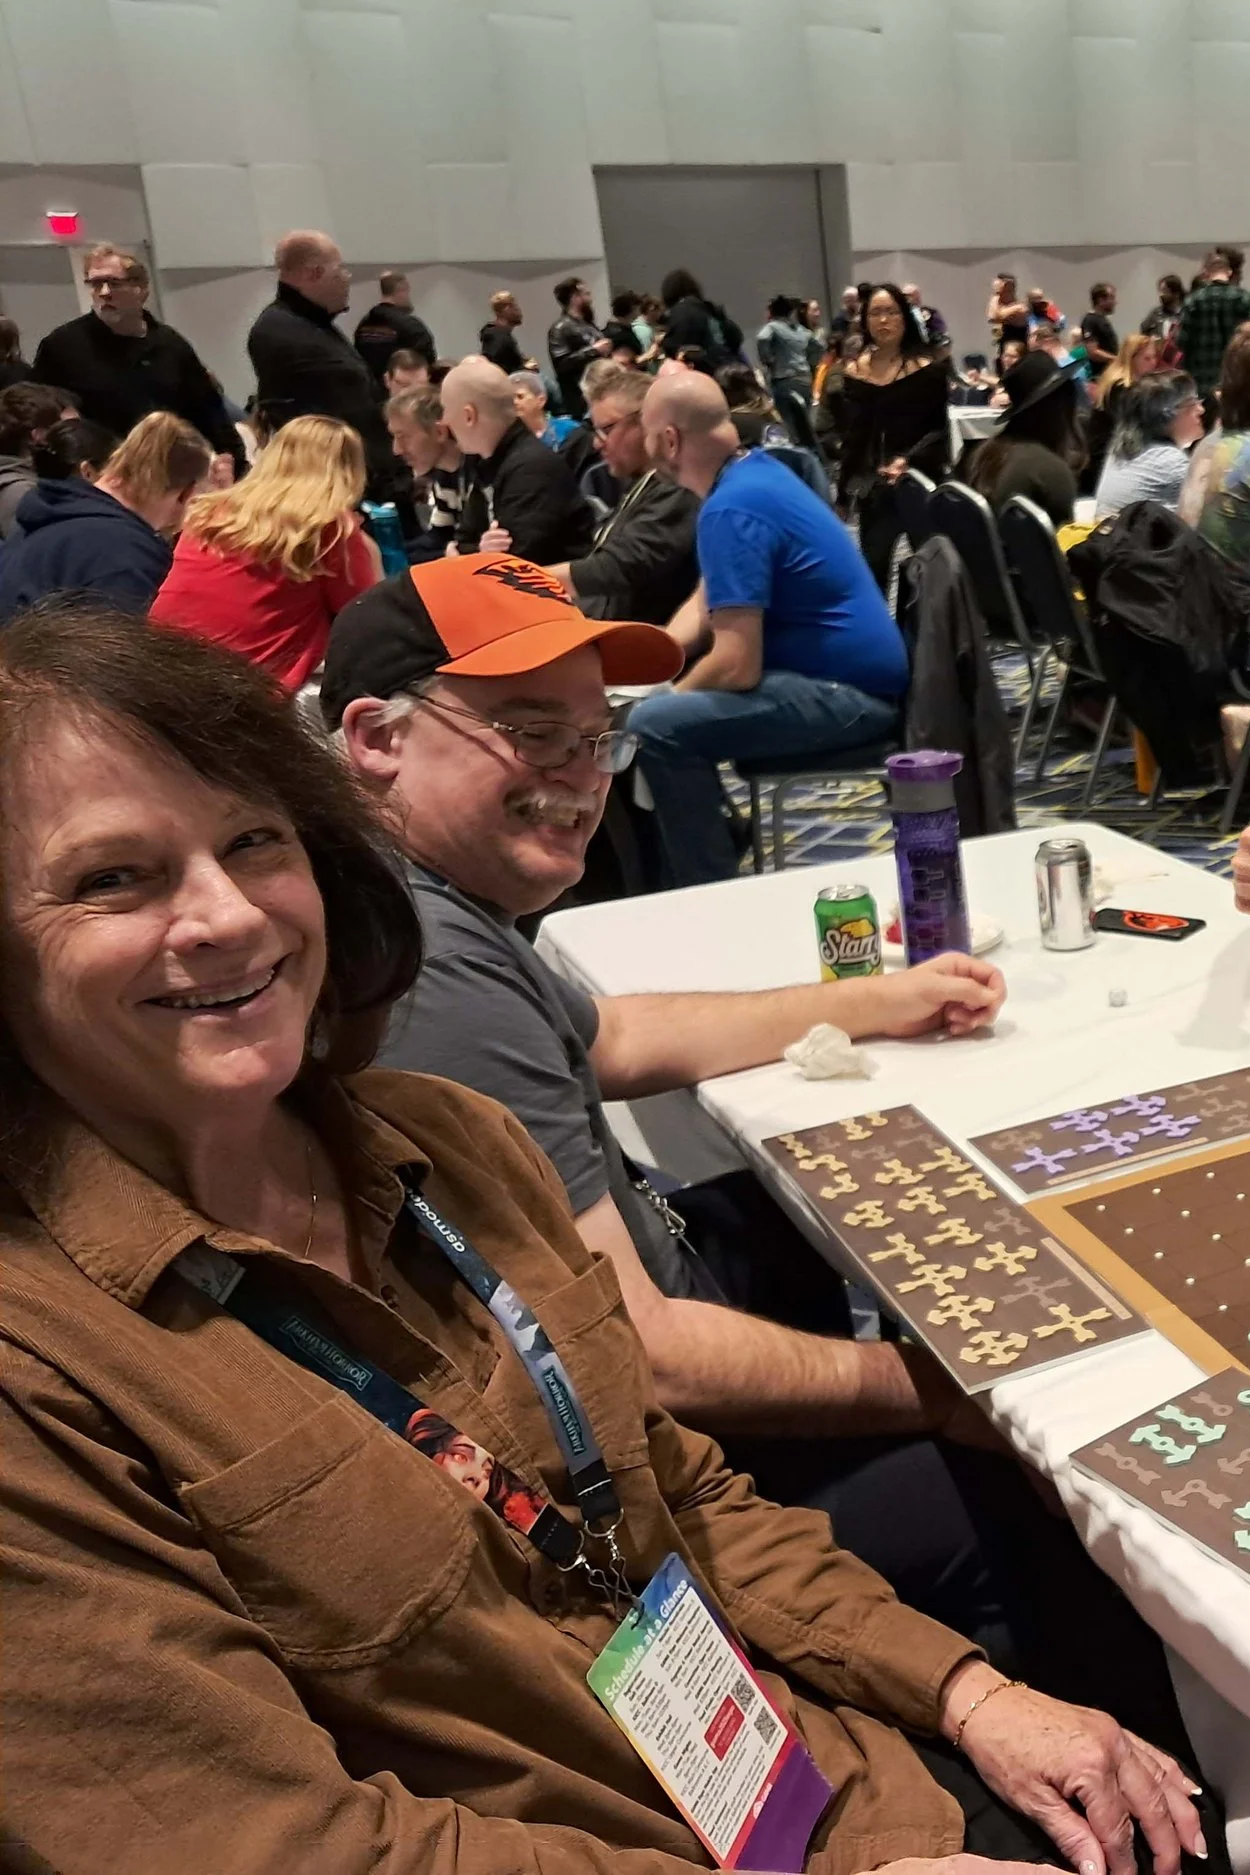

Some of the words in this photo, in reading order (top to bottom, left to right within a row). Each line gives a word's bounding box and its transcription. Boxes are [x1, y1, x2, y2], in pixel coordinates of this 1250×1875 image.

[603, 1639, 646, 1702] Schedule
[642, 1626, 656, 1646] at
[659, 1578, 688, 1620] Glance
